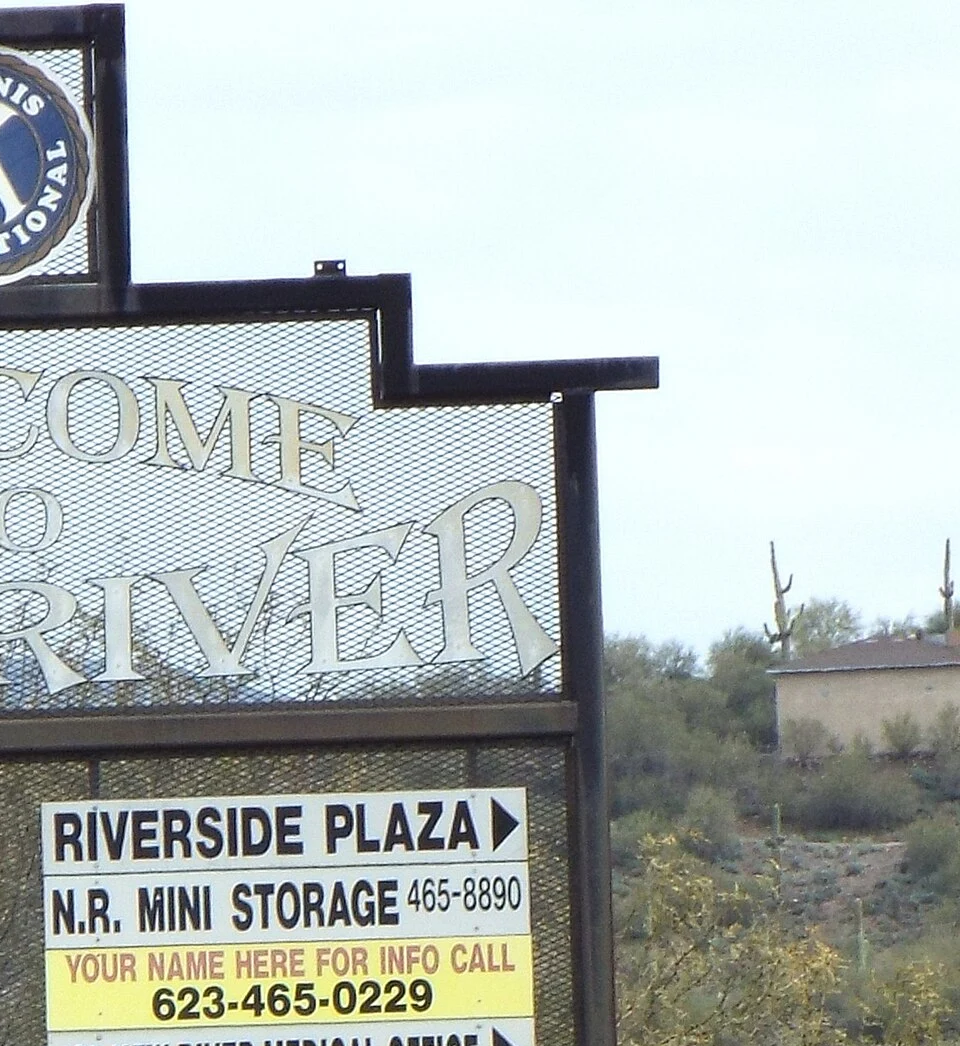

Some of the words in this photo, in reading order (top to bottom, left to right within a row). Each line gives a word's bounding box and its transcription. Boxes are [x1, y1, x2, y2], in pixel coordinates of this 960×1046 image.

[54, 805, 302, 862] RIVERSIDE
[327, 800, 478, 853] PLAZA
[53, 888, 121, 934] N.R.
[139, 885, 211, 932] MINI
[232, 881, 398, 931] STORAGE
[407, 876, 521, 912] 465-8890
[66, 953, 136, 984] YOUR
[148, 950, 224, 980] NAME
[236, 948, 304, 978] HERE
[317, 947, 368, 976] FOR
[381, 945, 439, 974] INFO
[451, 943, 515, 973] CALL
[152, 979, 432, 1020] 623-465-0229
